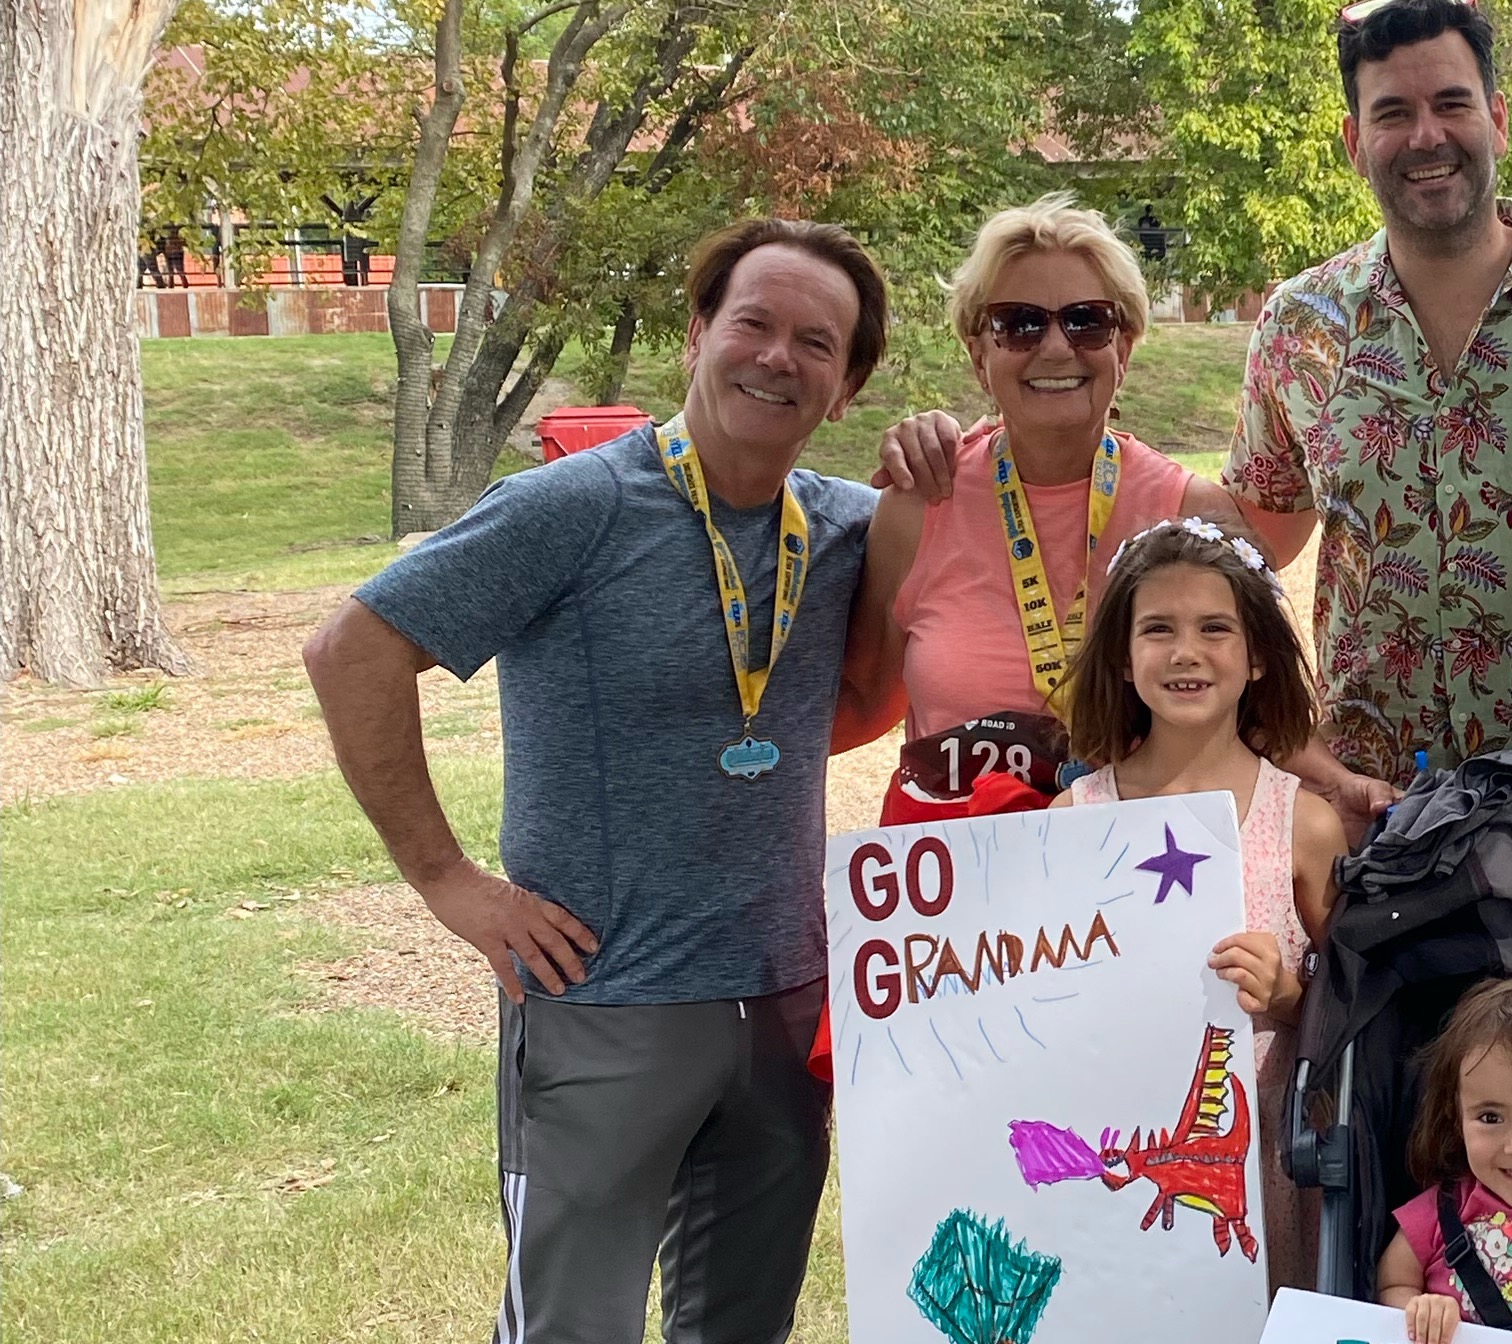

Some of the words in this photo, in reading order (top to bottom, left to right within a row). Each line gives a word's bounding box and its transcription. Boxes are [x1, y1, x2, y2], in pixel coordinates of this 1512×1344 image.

[1023, 597, 1048, 611] 10K
[1035, 661, 1062, 673] 50K
[981, 719, 1005, 729] ROAD
[940, 737, 1032, 791] 128
[849, 836, 953, 922] GO
[853, 909, 1120, 1020] GRANDMA
